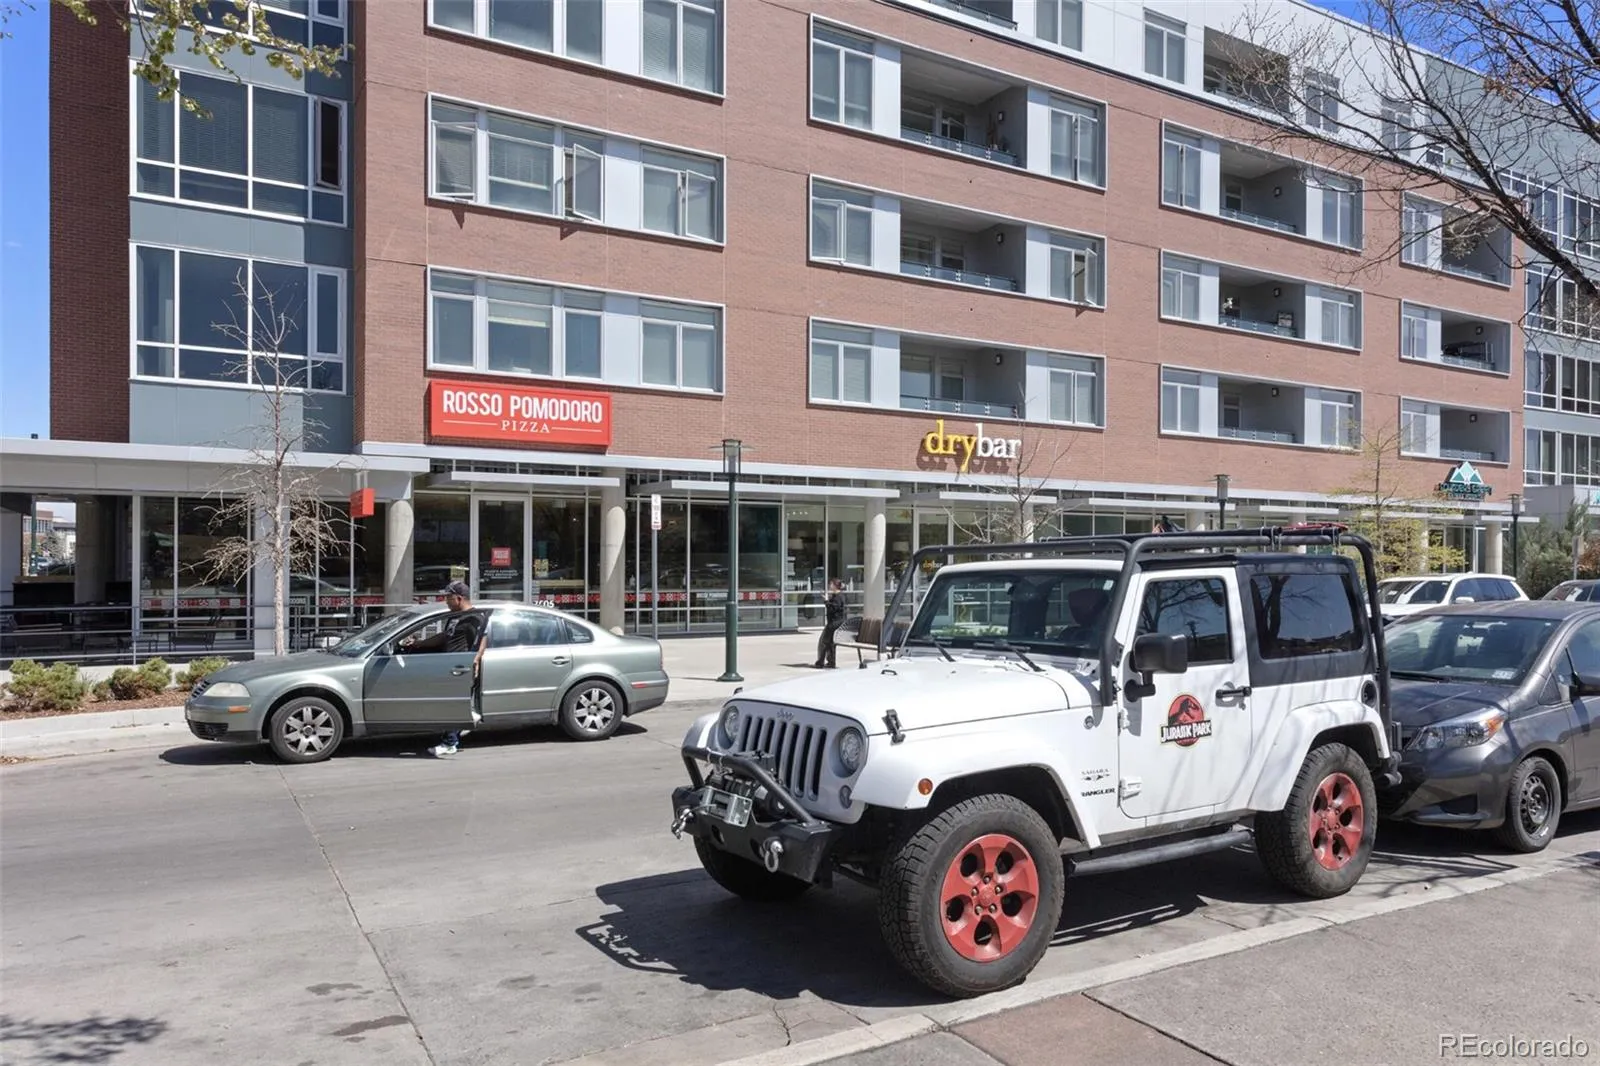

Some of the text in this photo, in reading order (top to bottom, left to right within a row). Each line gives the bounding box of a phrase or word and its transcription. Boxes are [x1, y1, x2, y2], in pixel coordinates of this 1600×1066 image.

[442, 390, 603, 424] ROSSO POMODORO
[501, 419, 551, 434] PIZZA
[925, 418, 1022, 473] drybar
[1192, 720, 1211, 738] PARK
